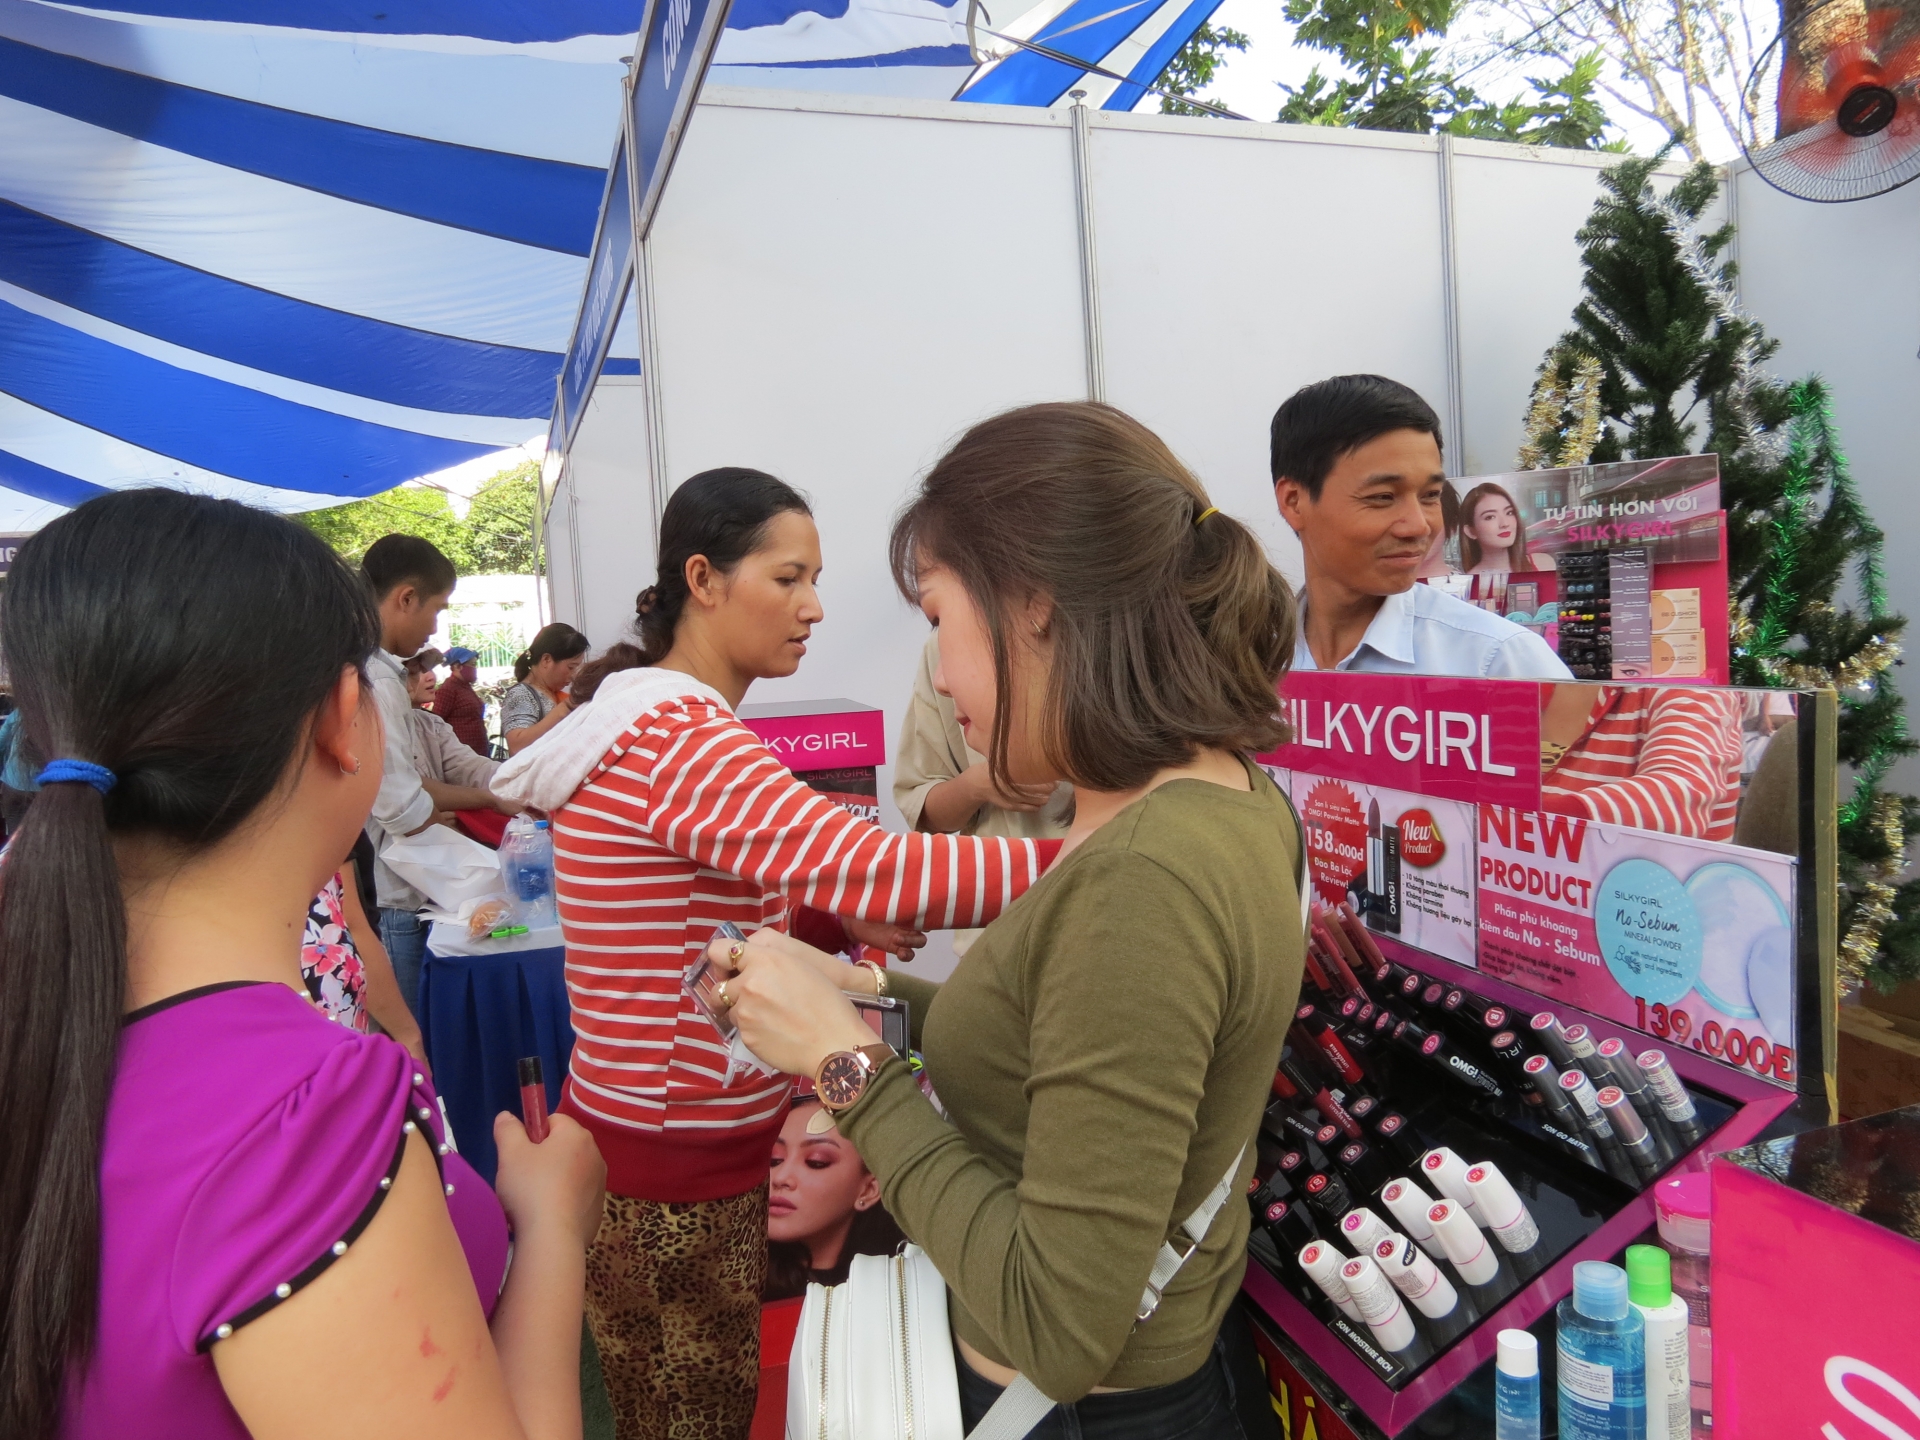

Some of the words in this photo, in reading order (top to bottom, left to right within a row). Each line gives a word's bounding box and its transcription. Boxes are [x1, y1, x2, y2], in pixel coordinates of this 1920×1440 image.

[1543, 505, 1567, 524] TỰ
[1572, 504, 1602, 520] TIN
[1609, 499, 1654, 517] HƠN
[1661, 494, 1697, 513] VỚI
[1567, 520, 1676, 543] SILKYGIRL
[764, 732, 868, 754] KYGIRL
[807, 768, 872, 781] SILKYGIRL
[1308, 807, 1322, 817] OMG!
[1323, 811, 1343, 822] Powder
[1344, 816, 1360, 826] Matte
[1402, 820, 1432, 841] New
[1477, 802, 1587, 864] NEW
[1404, 842, 1432, 854] Product
[1320, 872, 1349, 889] Review!
[1480, 855, 1591, 909] PRODUCT
[1388, 881, 1397, 915] OMG!
[1614, 890, 1663, 908] SILKYGIRL
[1540, 918, 1578, 940] khoáng
[1615, 908, 1680, 933] No-Sebum
[1522, 931, 1541, 948] No
[1554, 939, 1600, 967] Sebum
[1623, 930, 1651, 944] MINERAL
[1652, 937, 1682, 951] POWDER
[1449, 1055, 1479, 1078] OMG!
[1541, 1123, 1558, 1134] SON
[1556, 1131, 1569, 1140] GO
[1566, 1137, 1590, 1151] MATTE
[1335, 1320, 1351, 1334] SON
[1348, 1331, 1379, 1360] MOISTURE
[1376, 1356, 1394, 1372] RICH
